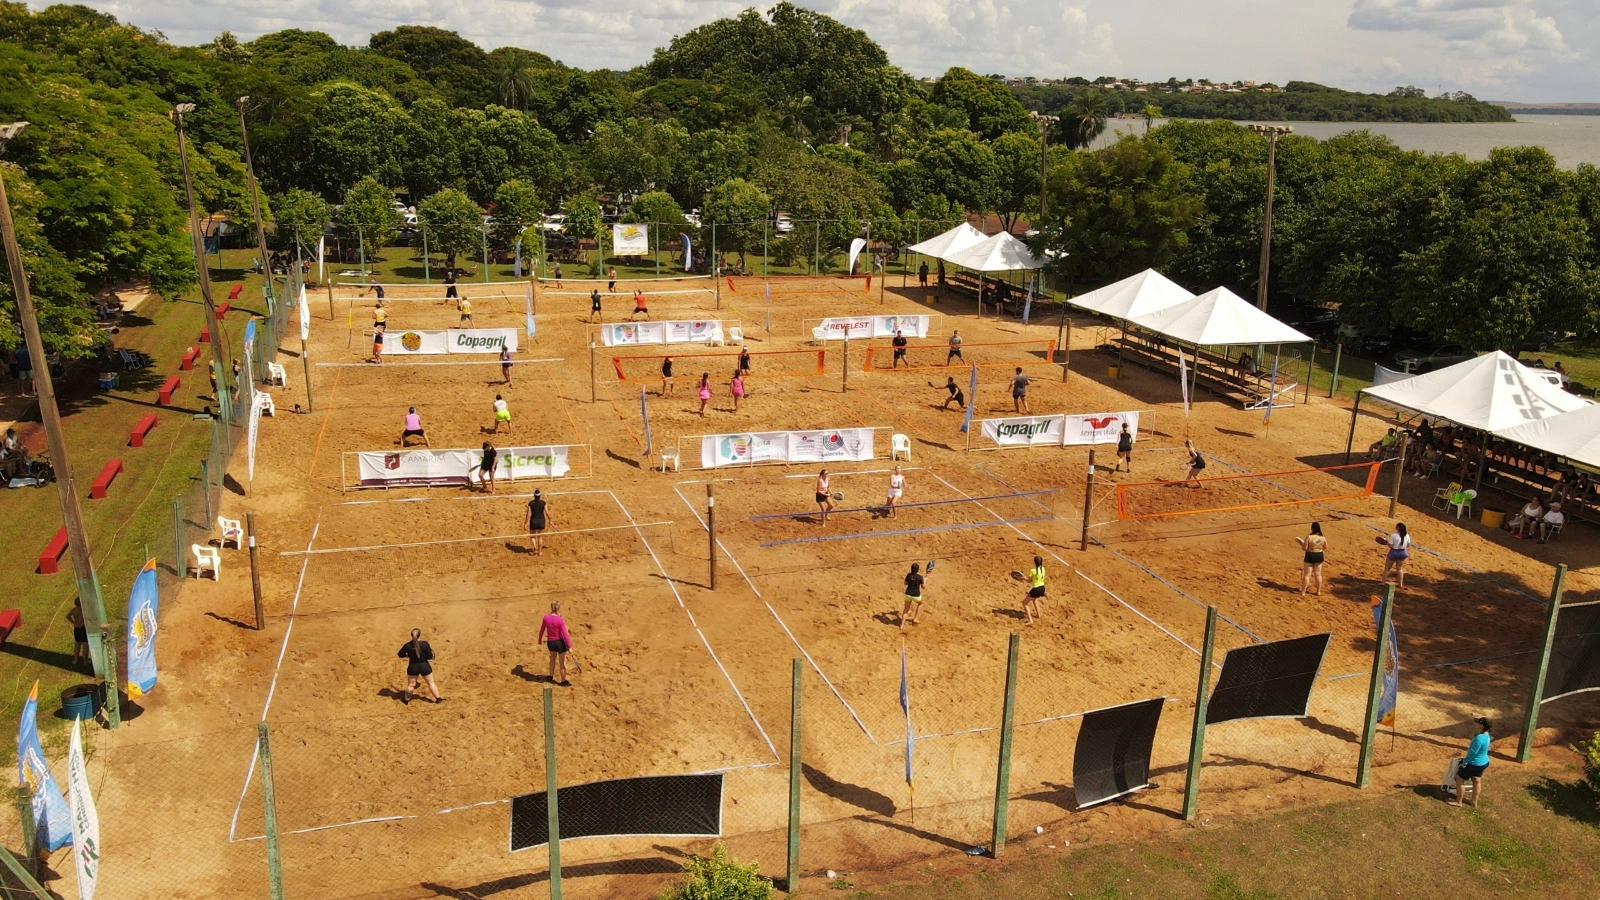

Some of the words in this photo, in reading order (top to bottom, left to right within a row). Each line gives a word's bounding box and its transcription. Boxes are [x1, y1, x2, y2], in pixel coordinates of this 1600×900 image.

[457, 333, 506, 348] Copagril
[997, 420, 1051, 439] Copagril
[401, 455, 446, 464] CAMARIM
[503, 452, 558, 469] Sicredi
